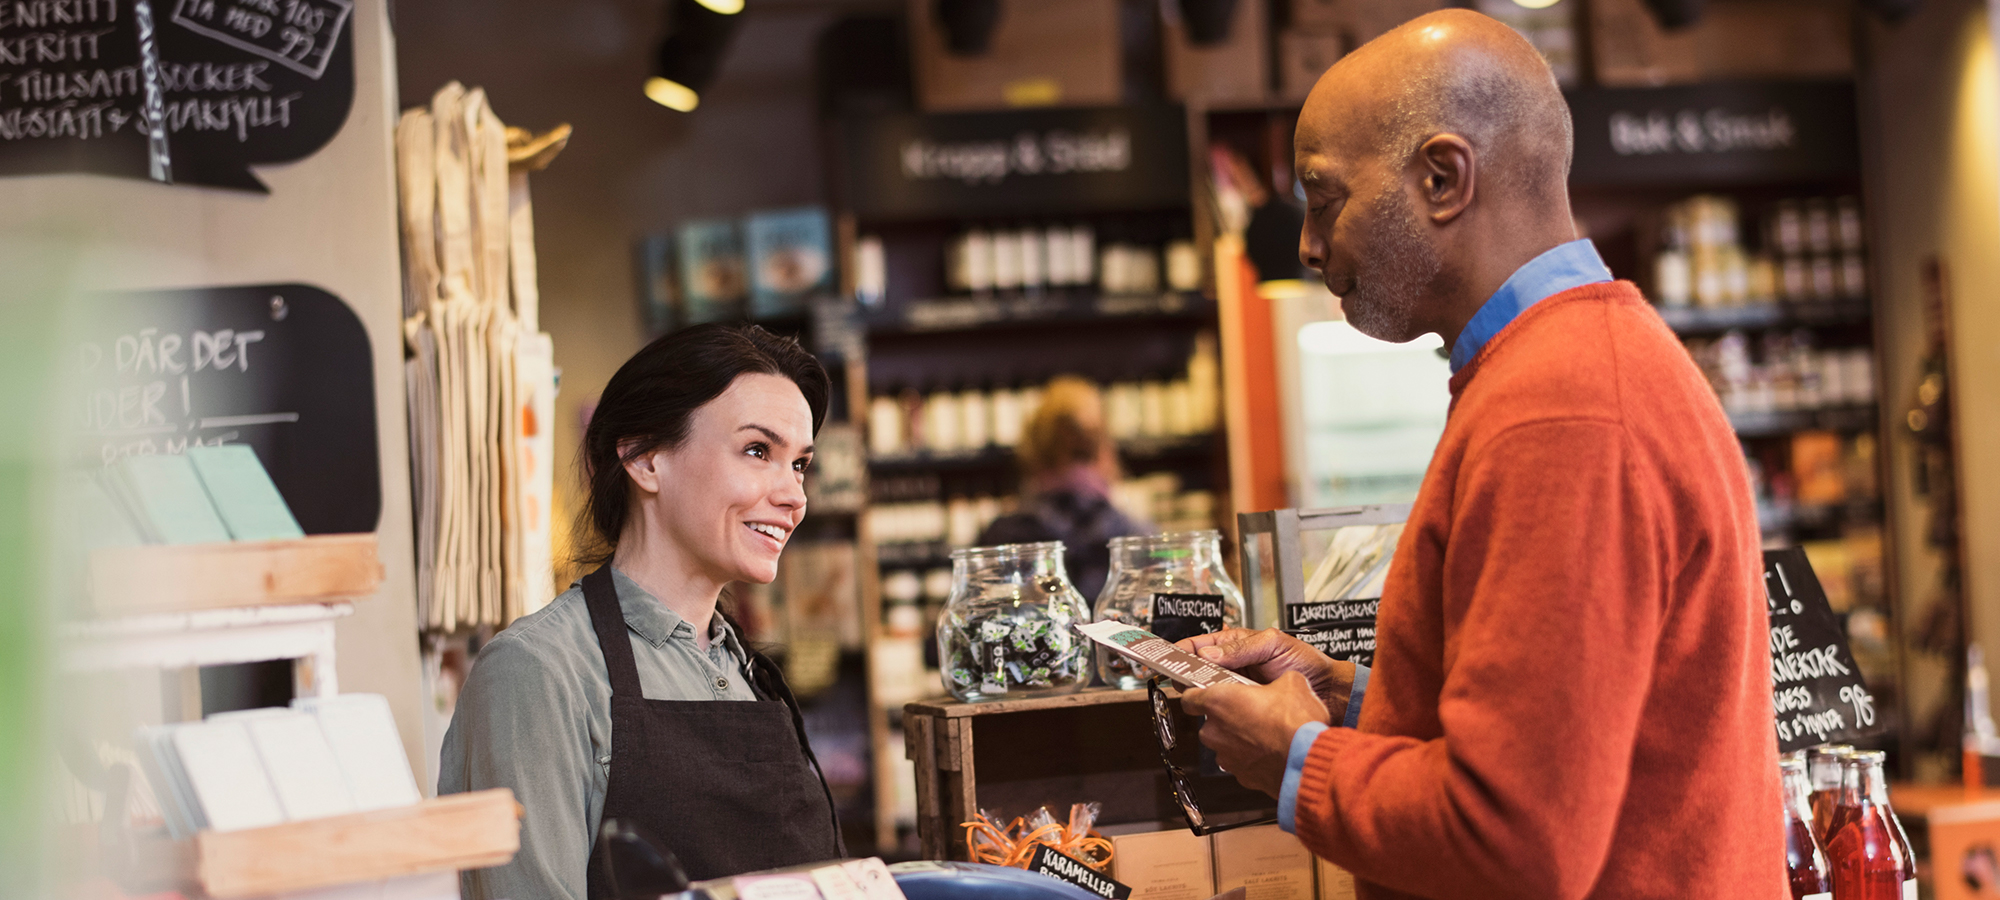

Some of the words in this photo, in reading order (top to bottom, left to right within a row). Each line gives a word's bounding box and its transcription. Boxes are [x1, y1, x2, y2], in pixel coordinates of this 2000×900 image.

[158, 61, 272, 92] SOCKER
[113, 326, 188, 375] DÄR
[191, 328, 266, 373] DET
[1042, 848, 1116, 899] KARAMELLER
